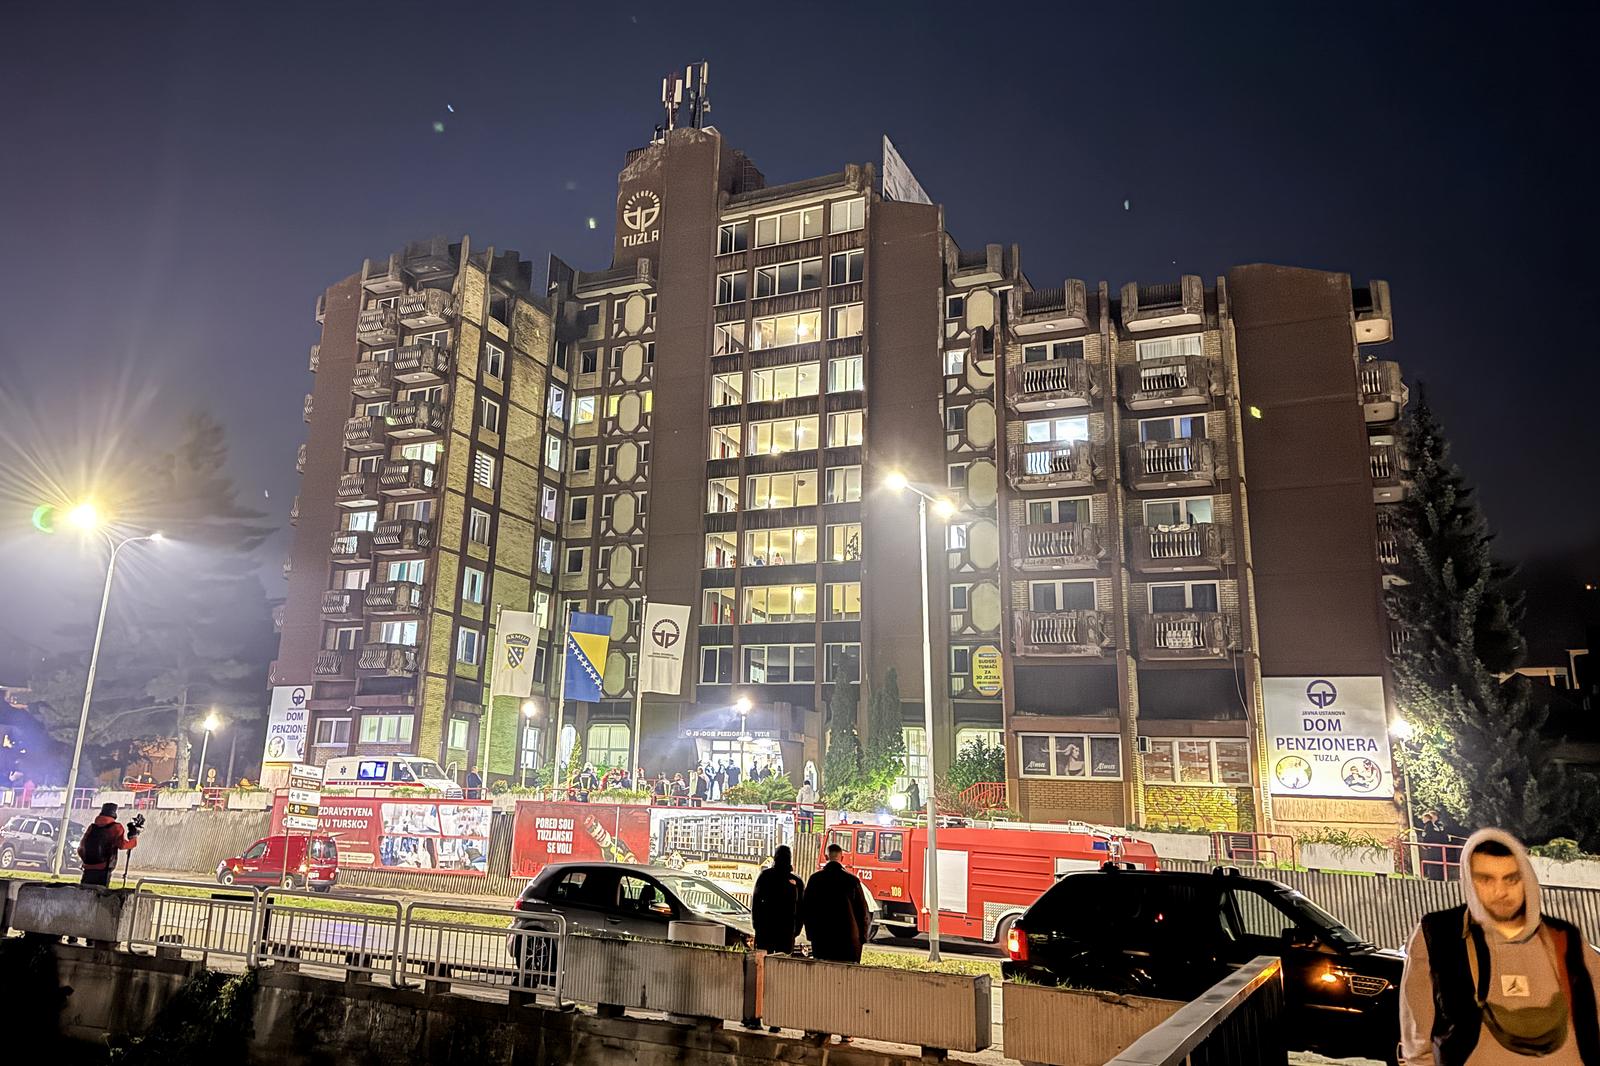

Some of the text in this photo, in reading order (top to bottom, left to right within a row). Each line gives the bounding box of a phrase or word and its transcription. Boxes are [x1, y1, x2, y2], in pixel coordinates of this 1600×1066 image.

[622, 229, 660, 248] TUZLA
[287, 712, 304, 721] DOM
[1303, 718, 1342, 732] DOM
[1276, 737, 1378, 752] PENZIONERA
[1313, 754, 1340, 762] TUZLA
[318, 806, 373, 817] ZDRAVSTVENA
[324, 818, 331, 828] U
[332, 819, 368, 829] TURSKOJ
[535, 817, 574, 830] PORED SOLI
[536, 829, 573, 842] TUZLANSKI
[547, 842, 572, 854] SE VOLI
[709, 871, 730, 879] PAZAR
[731, 872, 753, 880] TUZLA
[891, 886, 902, 897] 108
